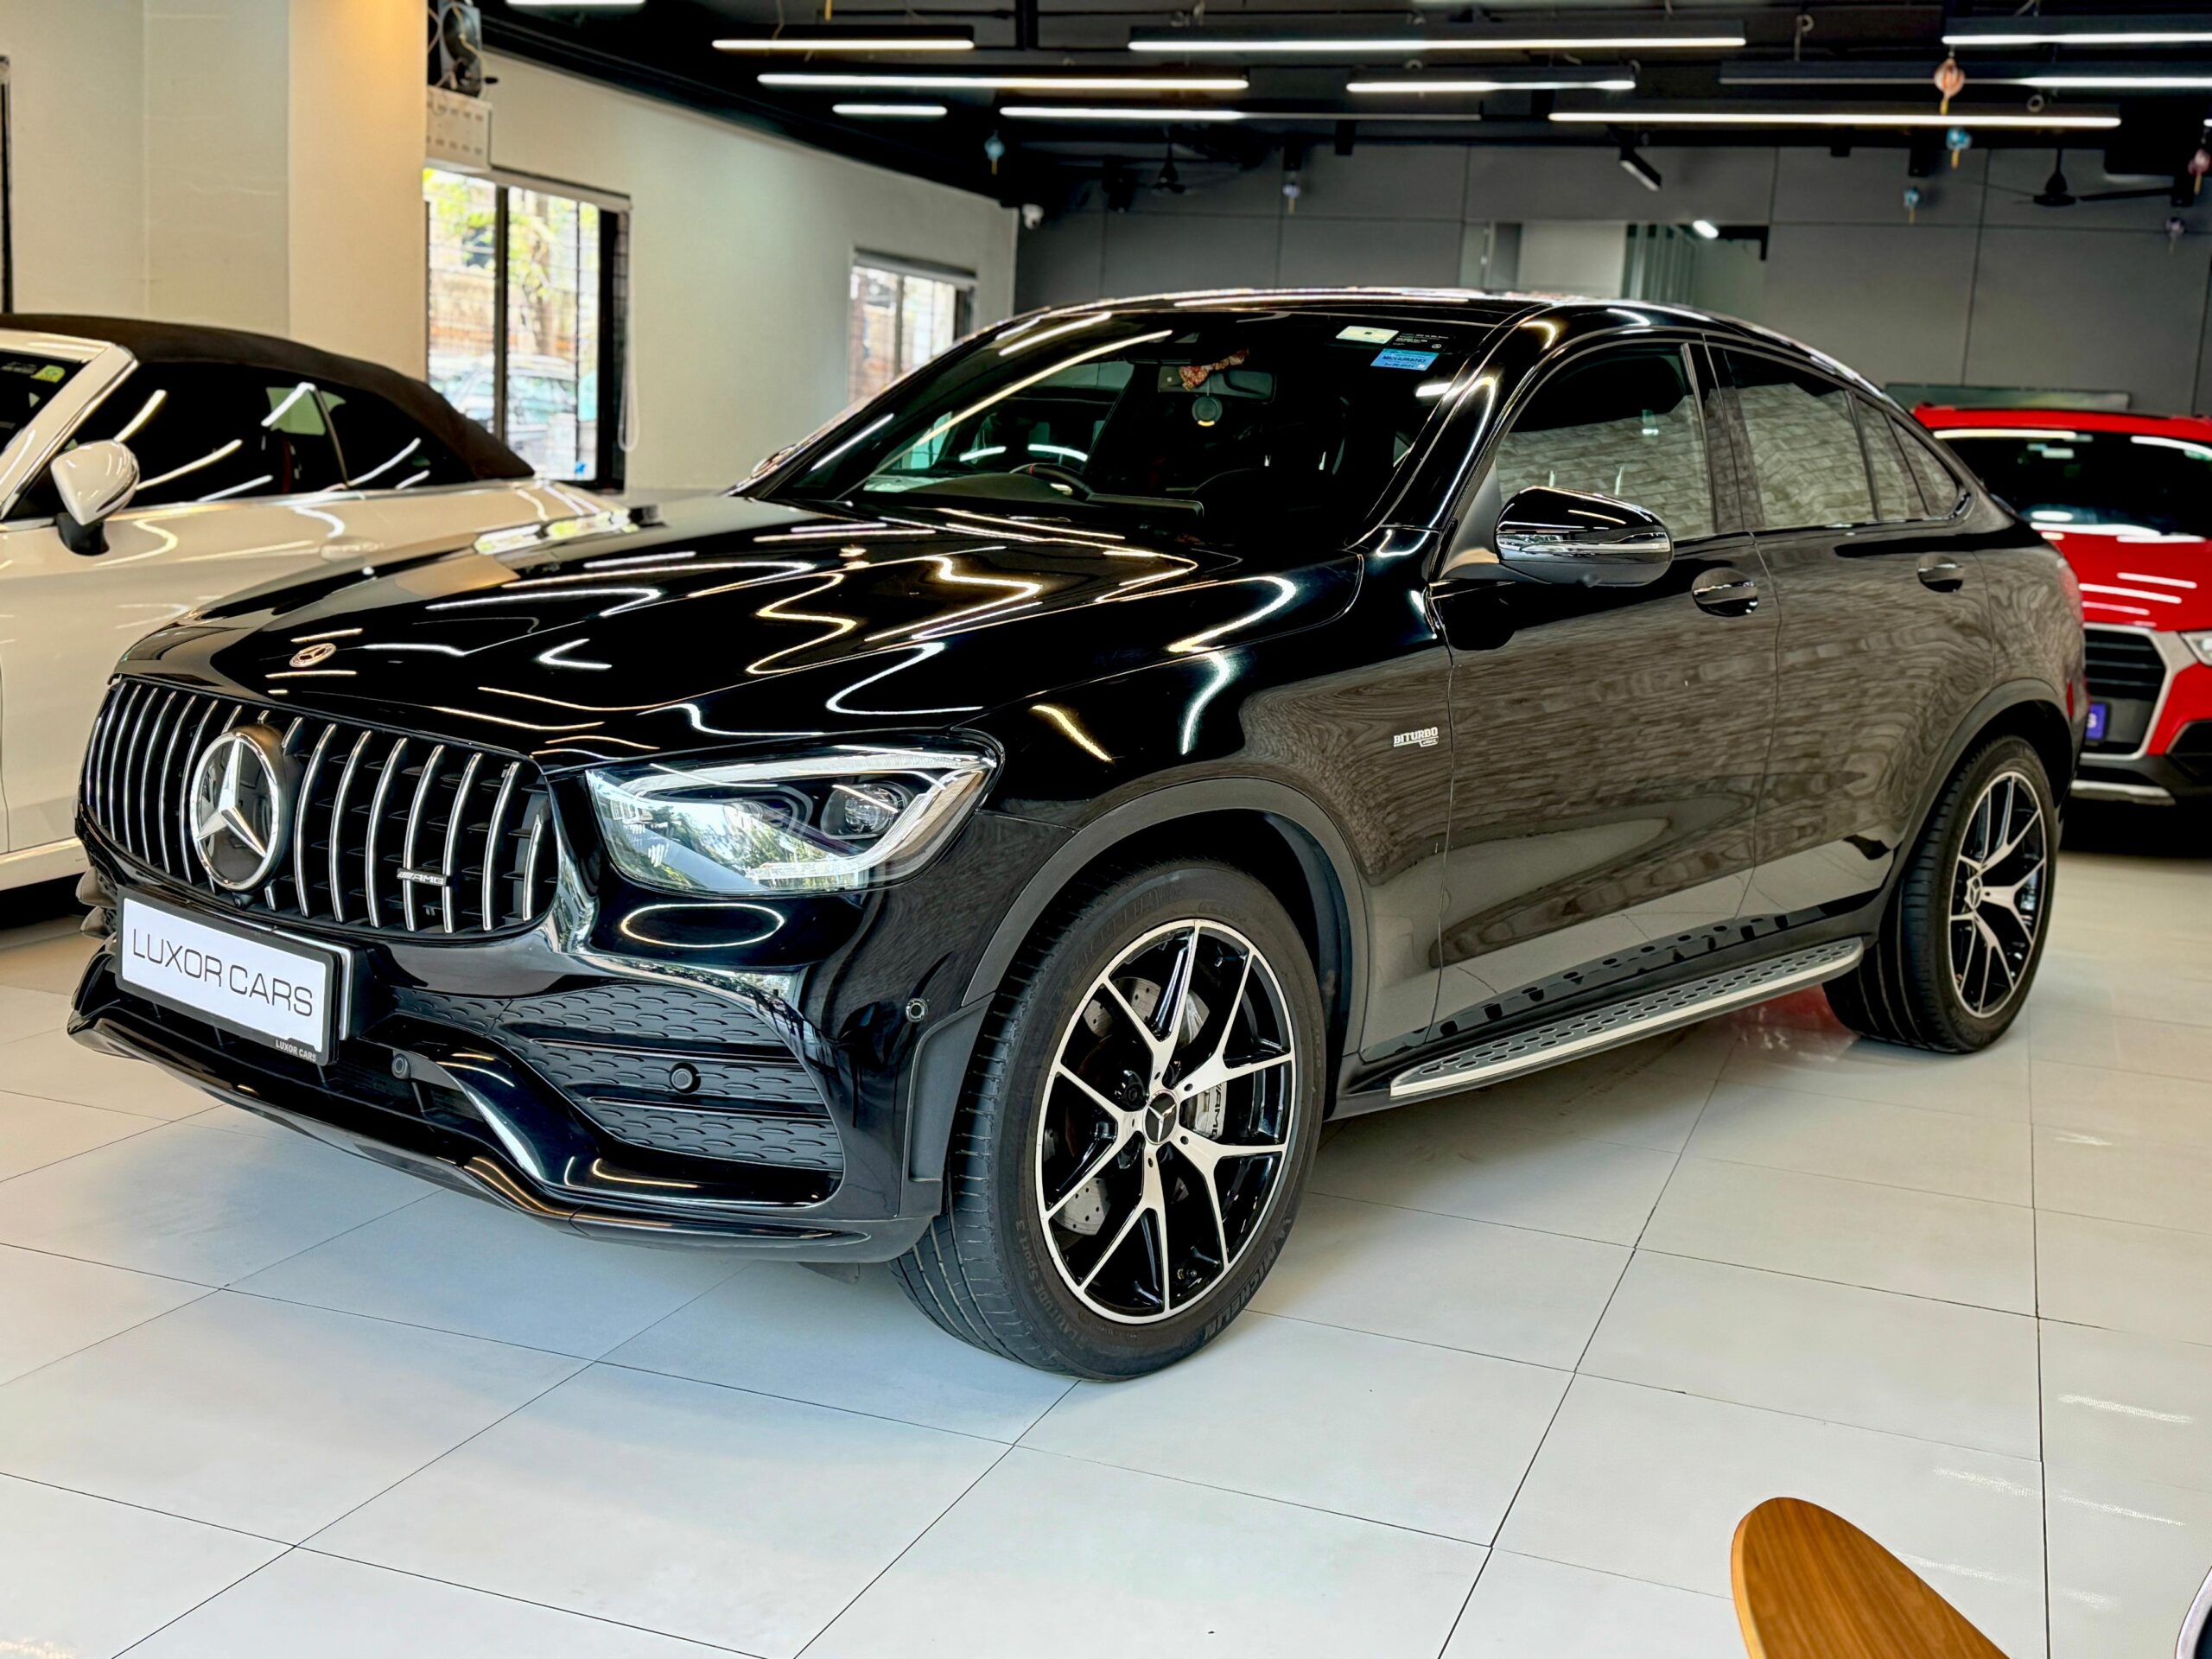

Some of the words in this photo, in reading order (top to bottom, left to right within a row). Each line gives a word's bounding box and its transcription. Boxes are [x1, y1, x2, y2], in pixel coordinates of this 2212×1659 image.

[1393, 727, 1439, 744] BITURBO
[411, 872, 444, 886] AMG
[133, 928, 222, 988] LUXOR
[229, 964, 313, 1017] CARS
[275, 1039, 298, 1055] LUXOR
[298, 1049, 317, 1063] CARS
[1015, 1219, 1026, 1231] 3
[1019, 1236, 1039, 1281] Sport
[1204, 1239, 1277, 1341] MICHELIN
[1033, 1282, 1079, 1341] LATITUDE
